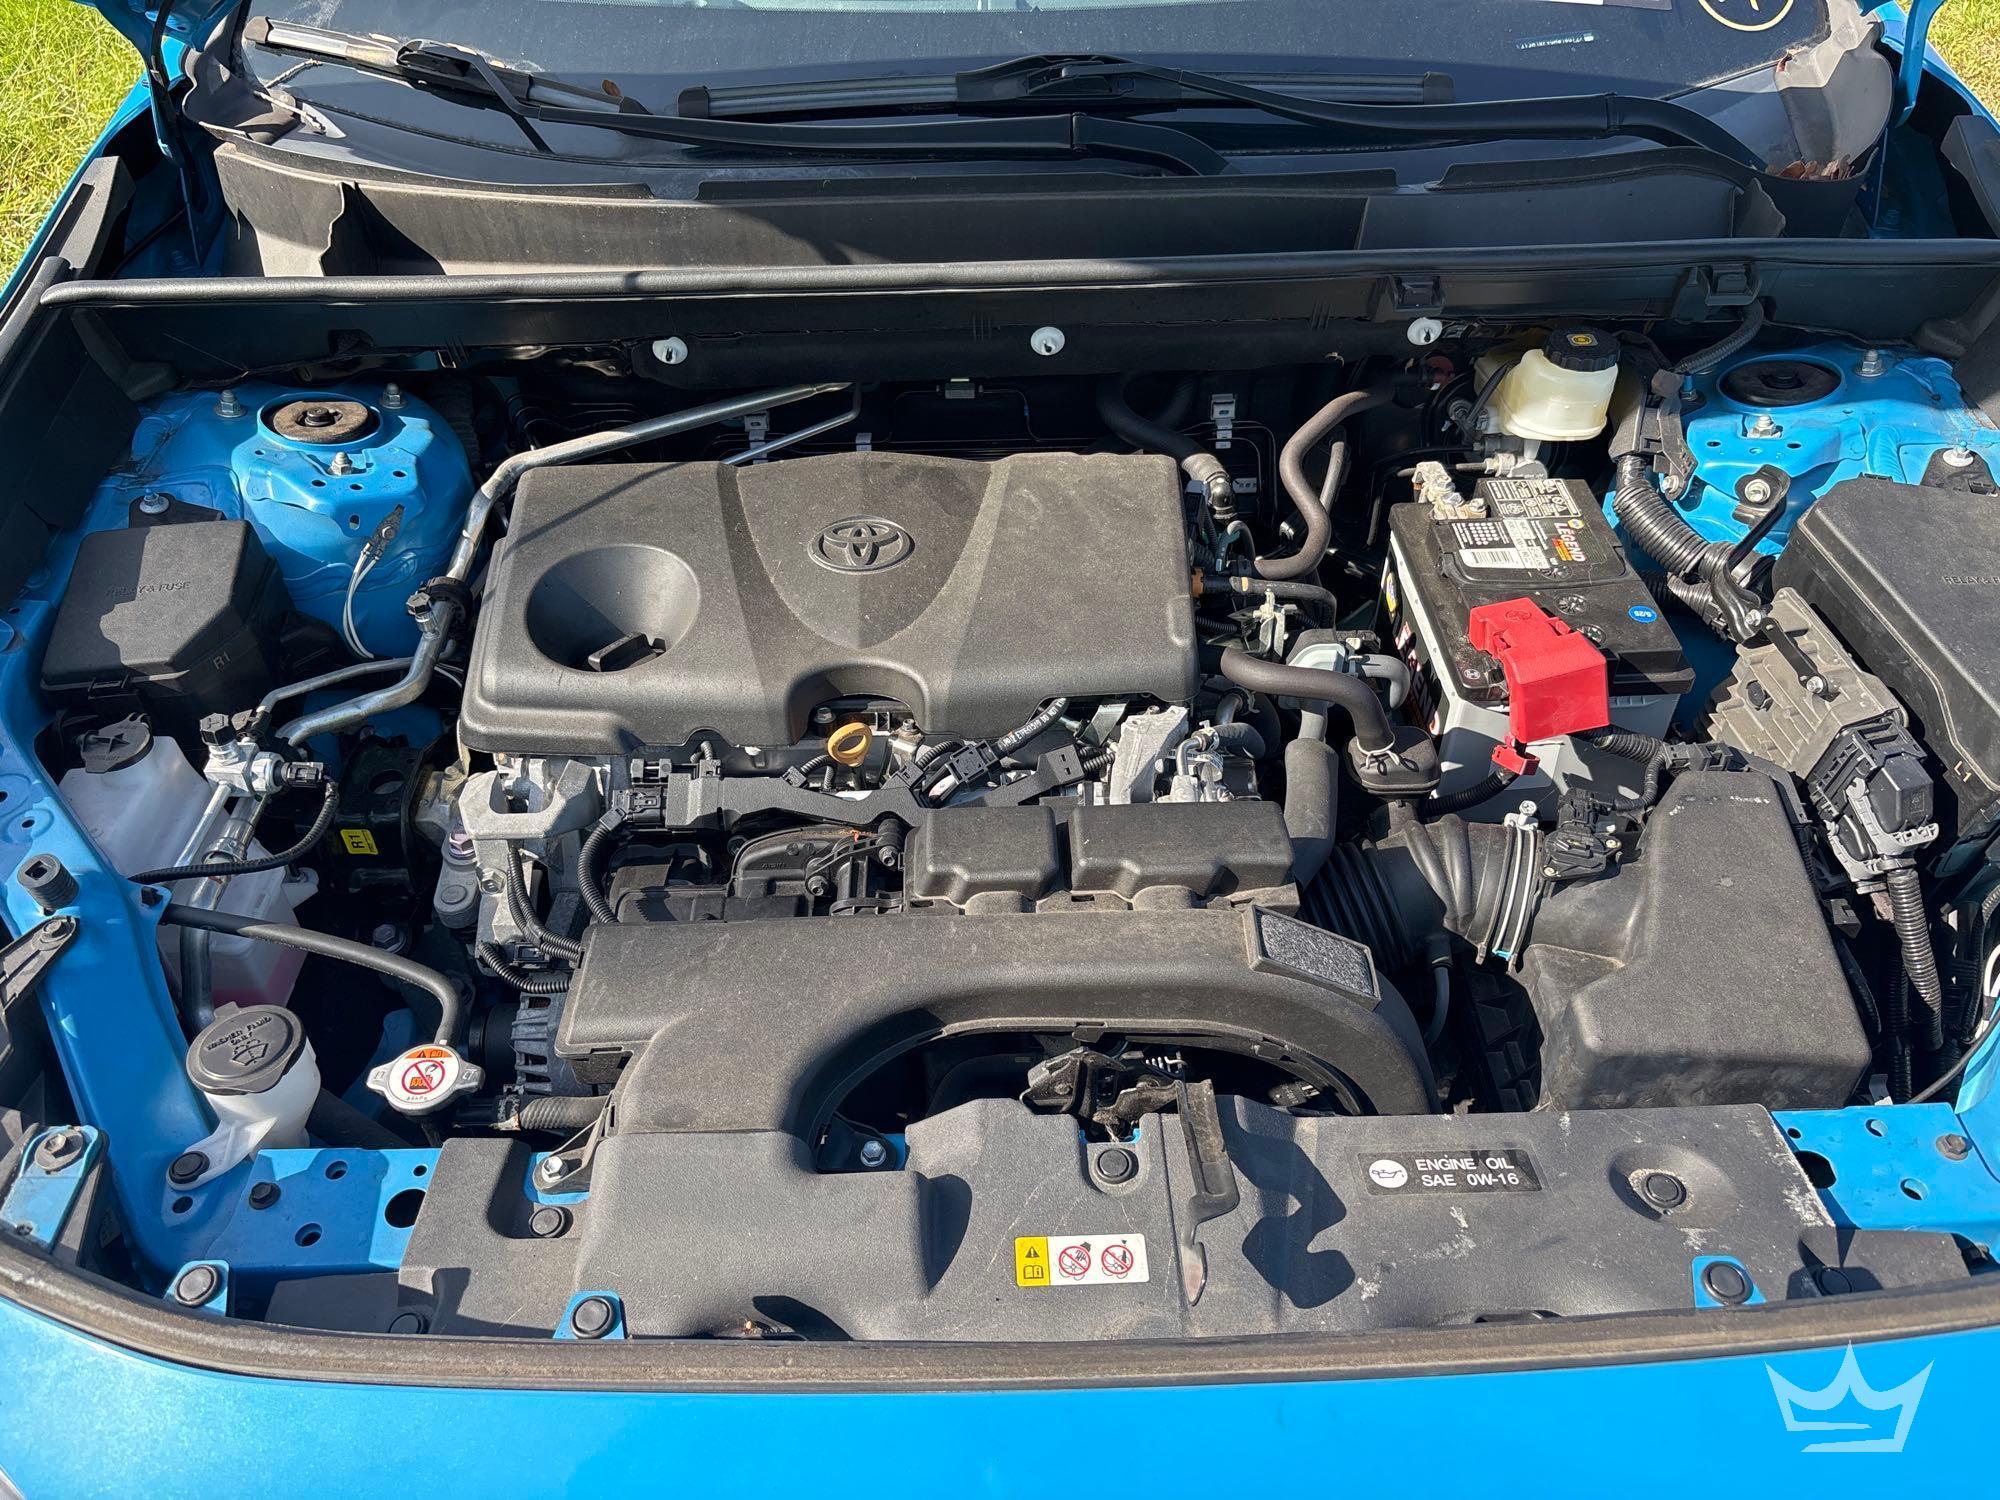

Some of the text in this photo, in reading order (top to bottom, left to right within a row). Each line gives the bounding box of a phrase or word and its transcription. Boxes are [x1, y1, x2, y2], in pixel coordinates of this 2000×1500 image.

[1554, 522, 1586, 562] LEGEND
[158, 581, 191, 592] FUSE
[1942, 576, 1979, 585] RELAY
[1954, 761, 1972, 782] L1
[348, 834, 366, 849] R1
[1415, 1157, 1515, 1171] ENGINE OIL
[1421, 1173, 1519, 1187] SAE 0W-16
